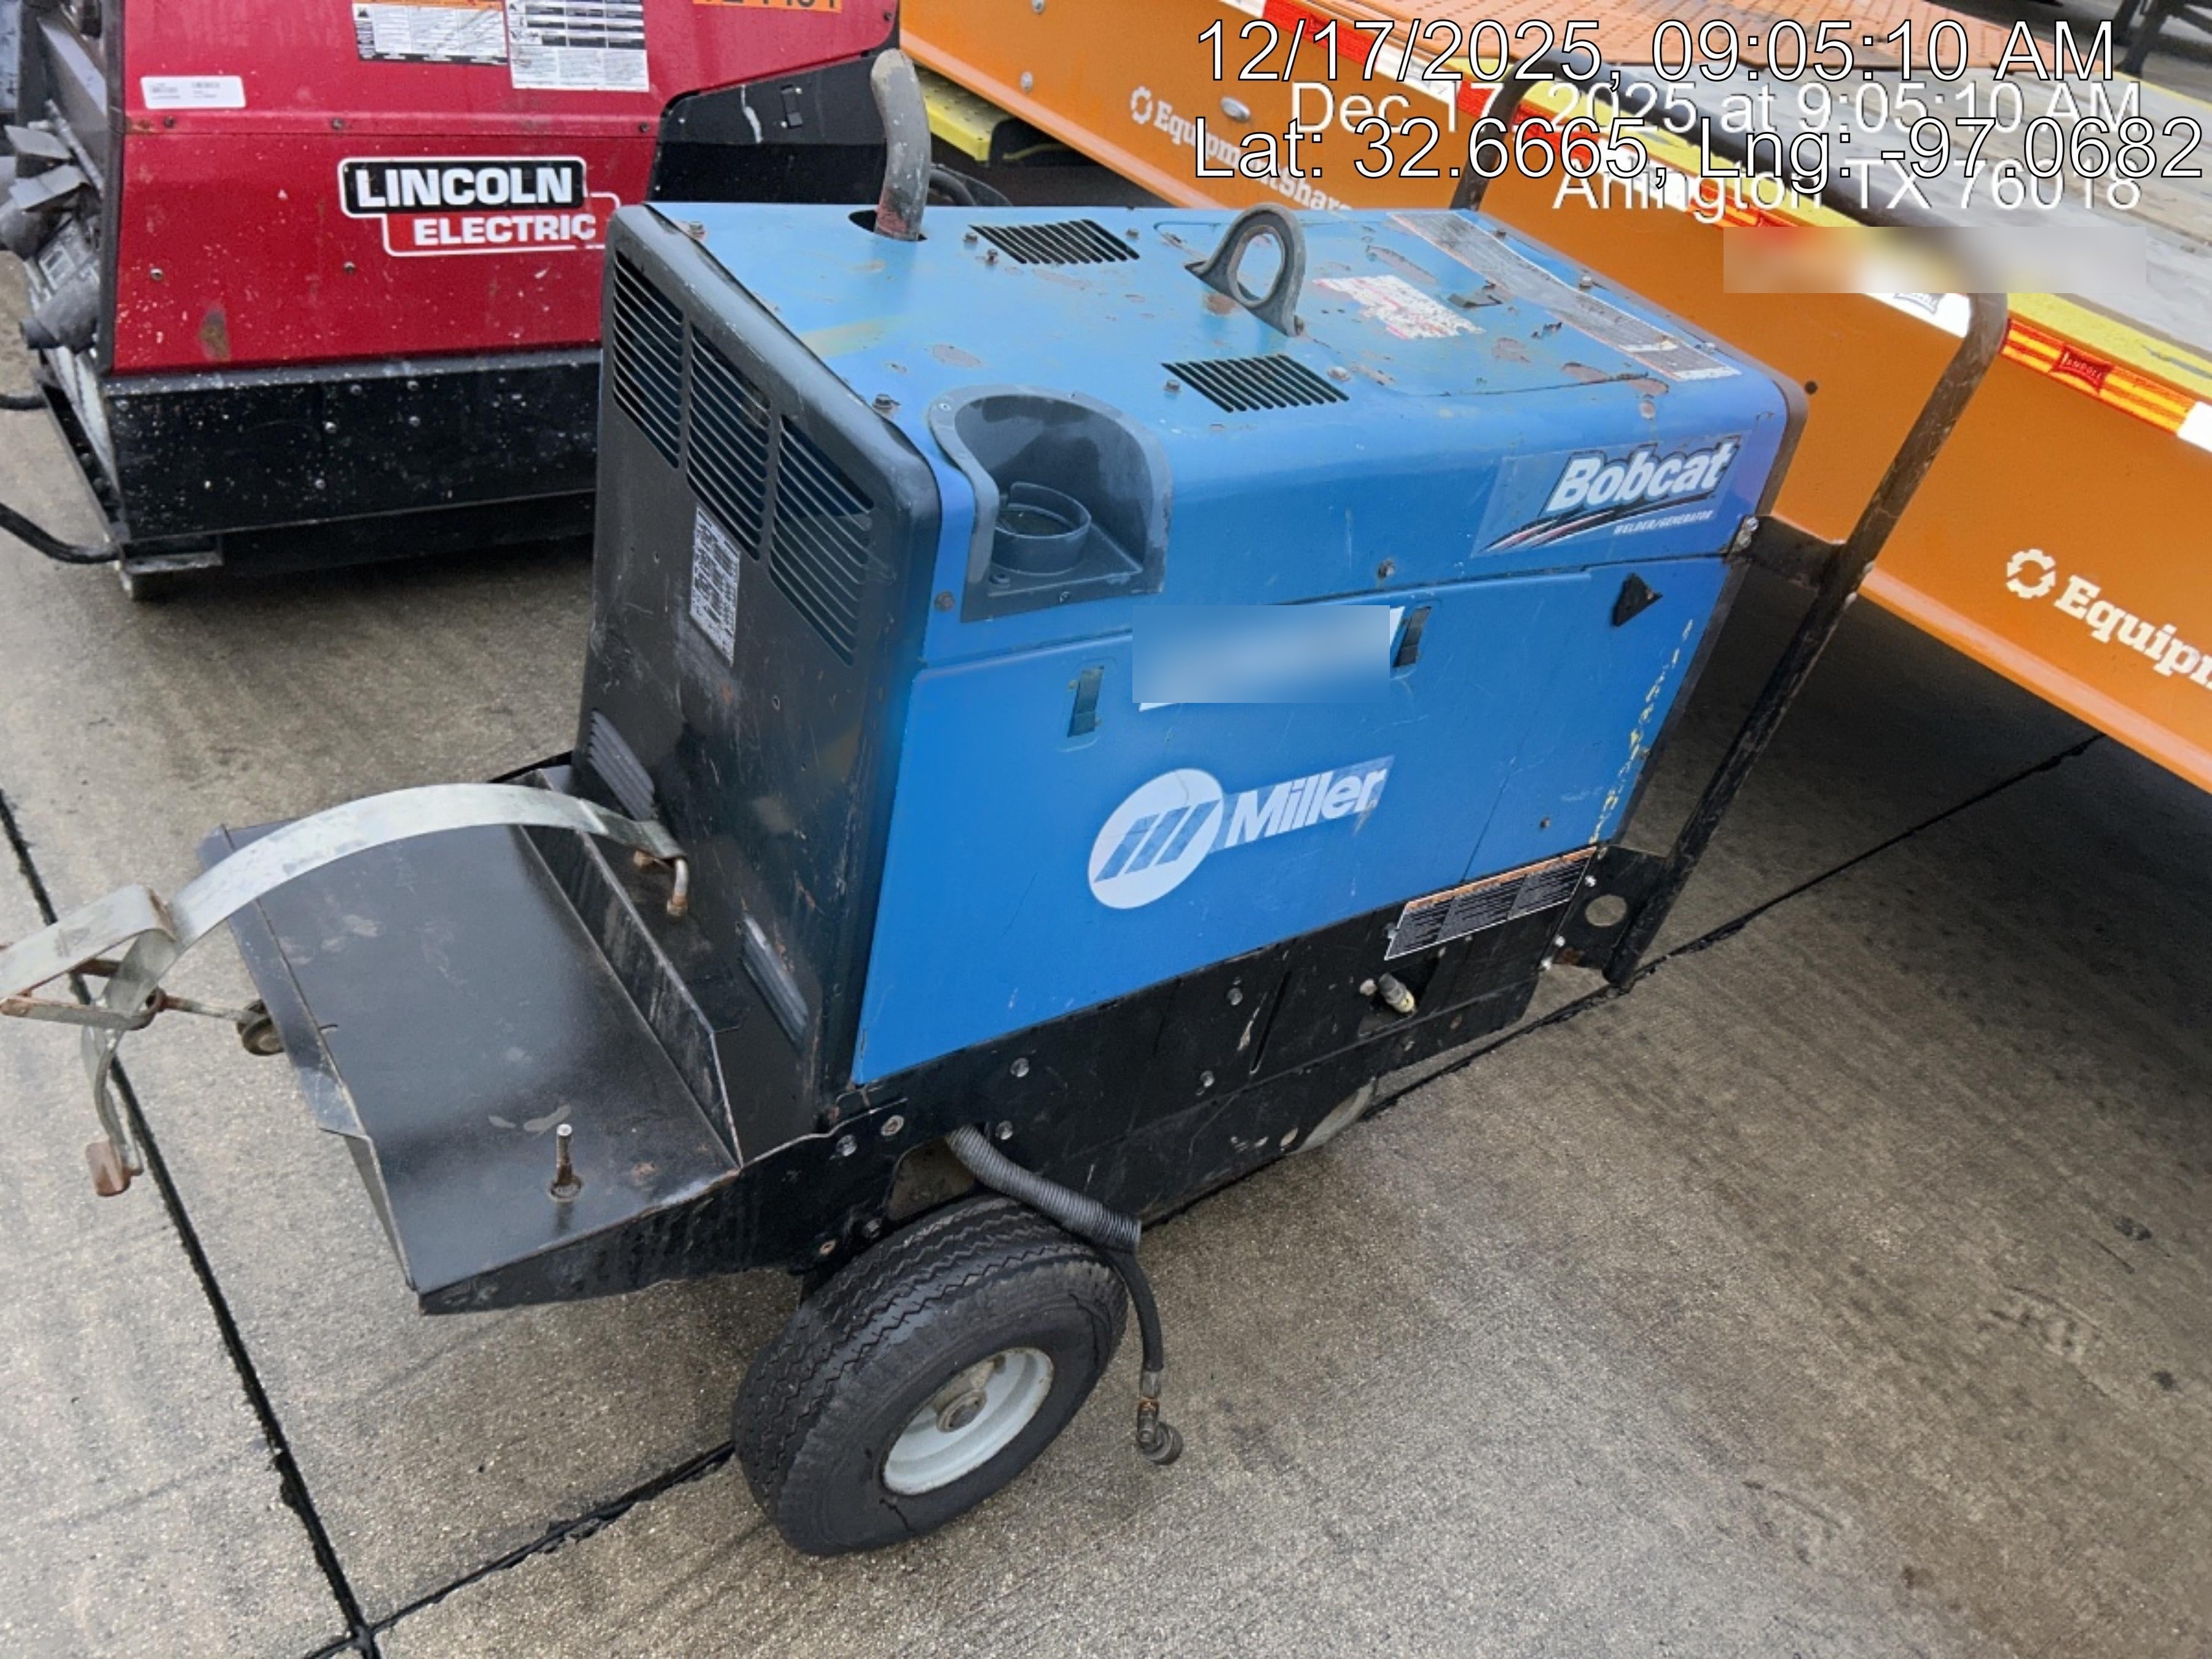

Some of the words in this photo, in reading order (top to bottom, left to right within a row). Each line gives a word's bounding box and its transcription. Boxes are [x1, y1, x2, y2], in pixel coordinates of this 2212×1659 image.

[355, 167, 573, 208] LINCOLN
[413, 213, 597, 246] ELECTRIC
[1545, 441, 1734, 512] Bobcat
[1223, 768, 1387, 849] Miller
